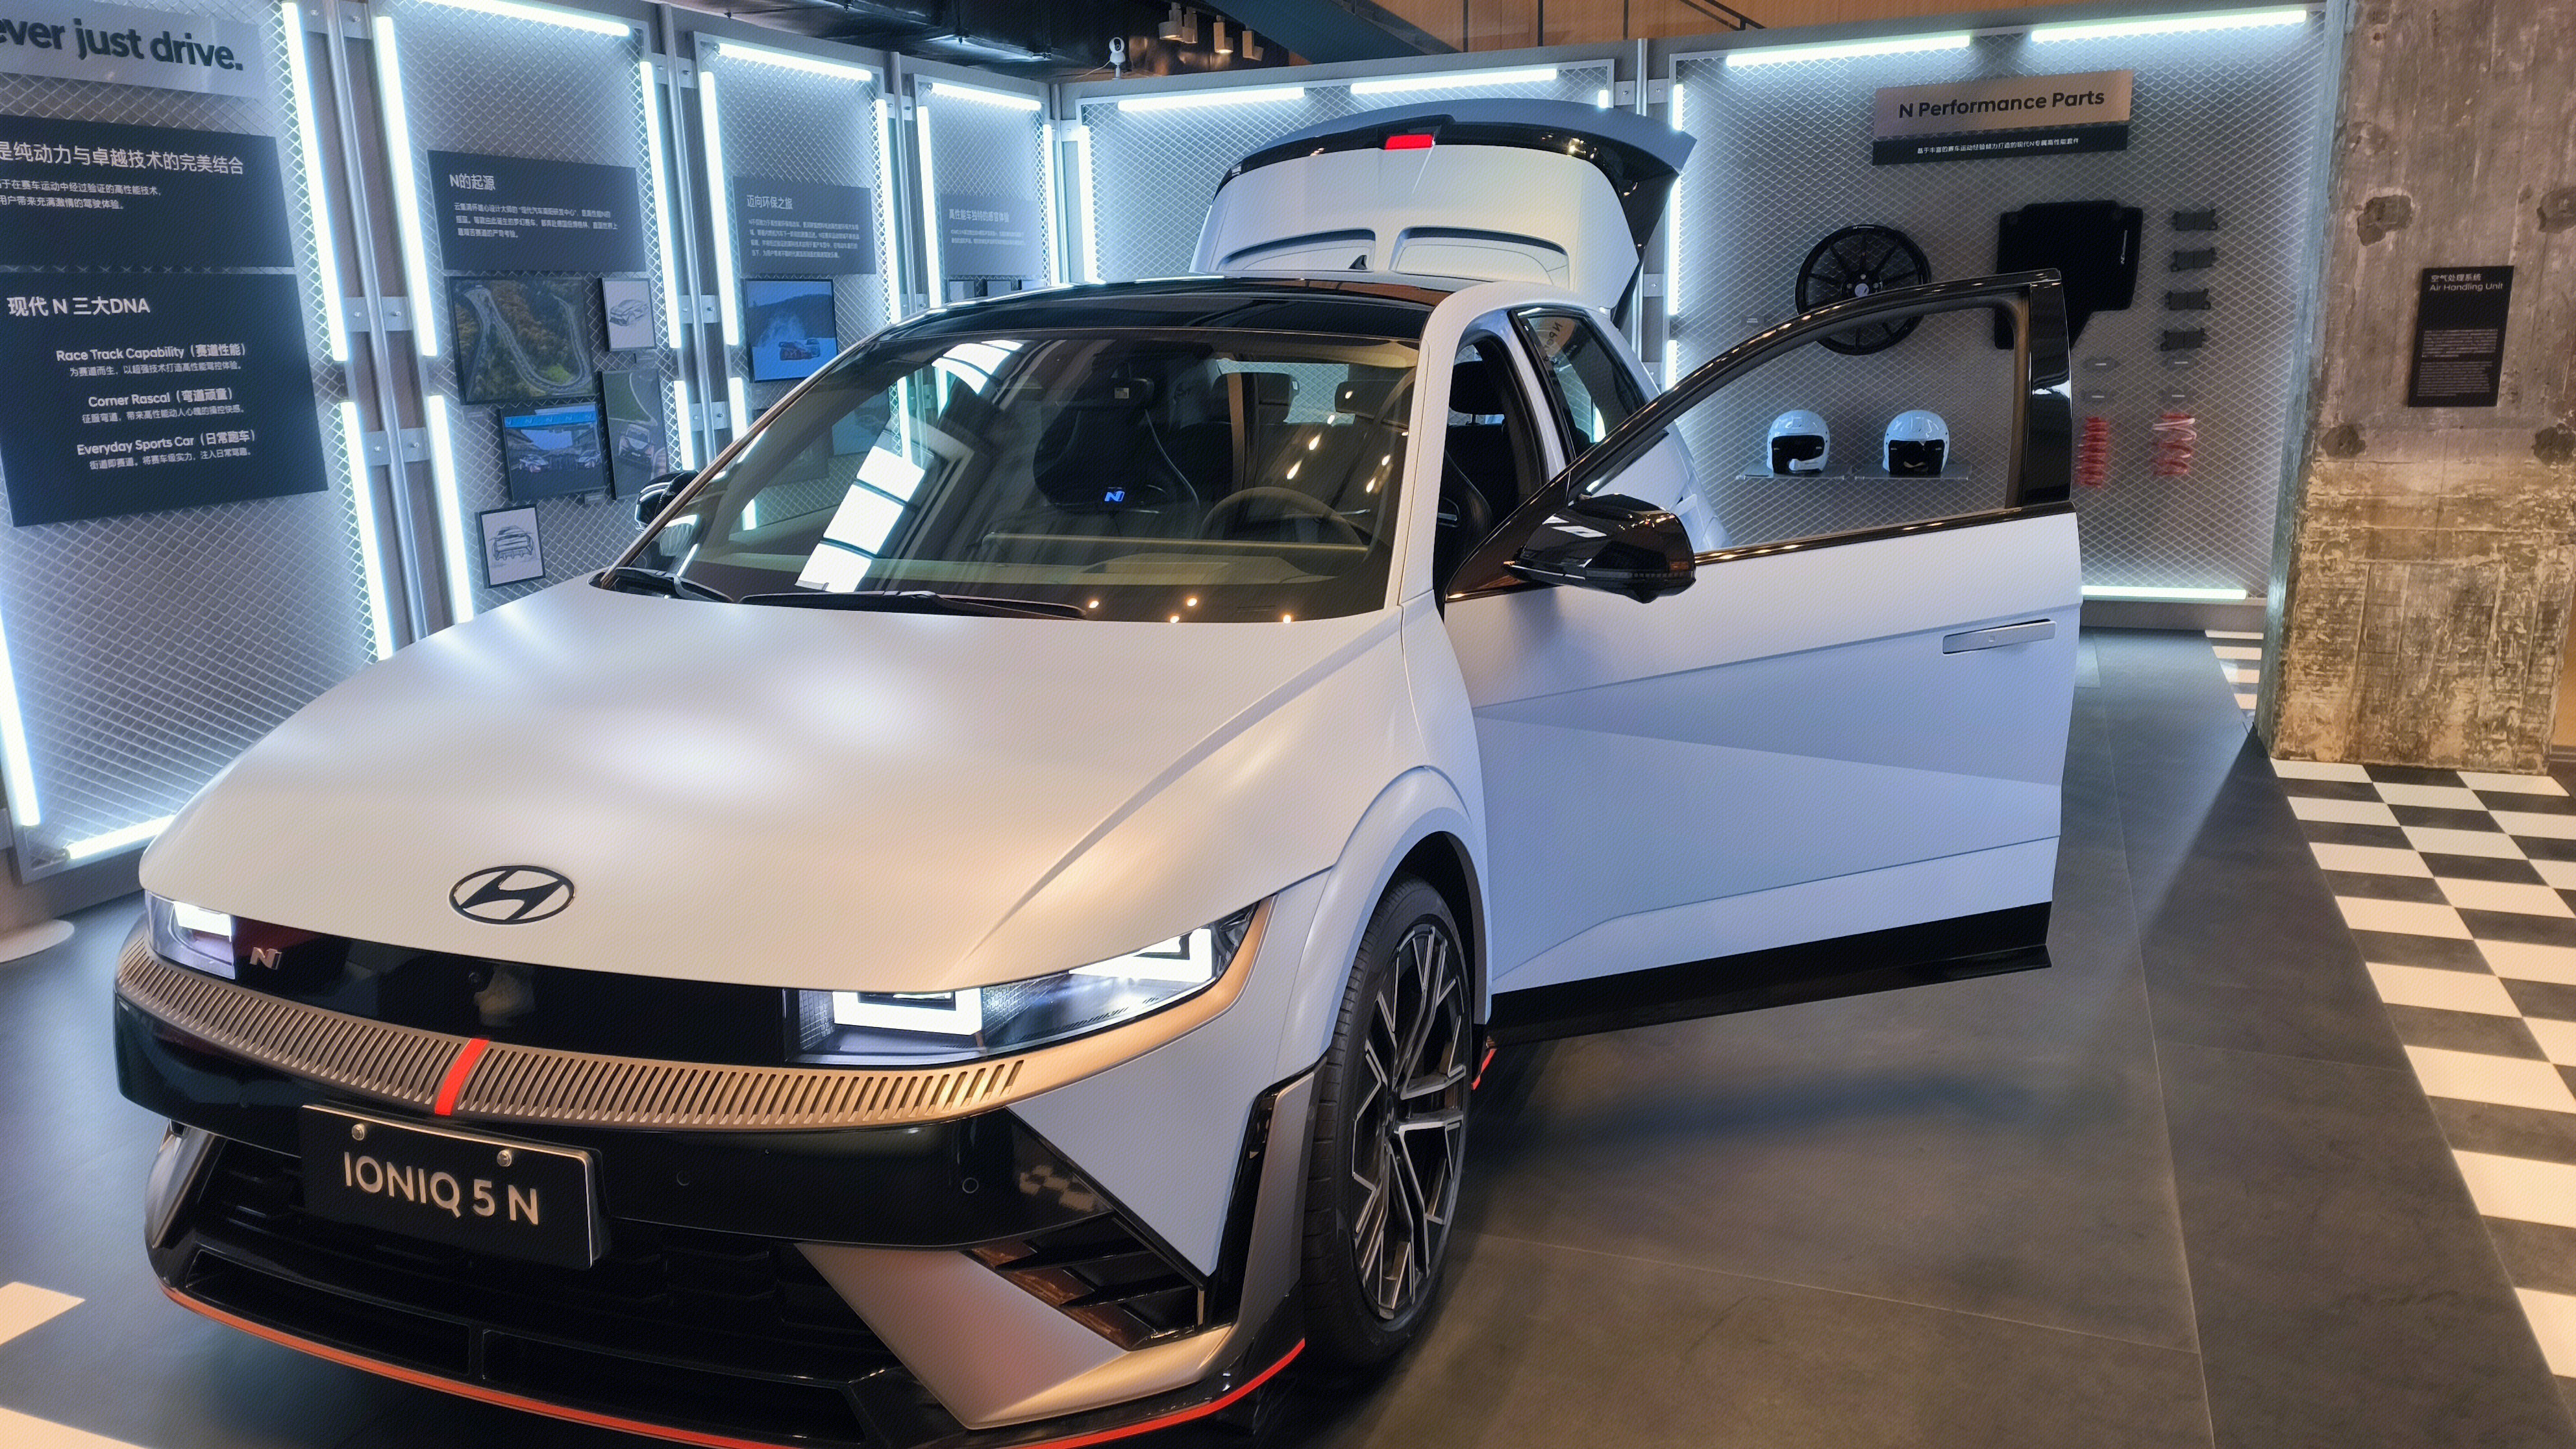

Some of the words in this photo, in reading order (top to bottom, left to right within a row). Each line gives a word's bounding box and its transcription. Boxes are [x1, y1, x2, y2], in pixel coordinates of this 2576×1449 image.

[73, 18, 145, 60] just
[150, 31, 243, 71] drive.
[1899, 103, 1913, 118] N
[1918, 97, 2047, 118] Performance
[2052, 91, 2105, 108] Parts
[0, 141, 243, 175] 是纯动力与卓越技术的完美结合
[0, 179, 162, 196] 于在赛车运动中经过验证的高性能技术，
[449, 173, 496, 191] N的起源
[746, 195, 793, 210] 迈向环保之旅
[2444, 283, 2483, 292] Handling
[2486, 282, 2503, 290] Unit
[6, 296, 49, 316] 现代
[53, 298, 68, 314] N
[73, 296, 151, 316] 三大DNA
[56, 349, 88, 362] Race
[90, 348, 123, 360] Track
[126, 346, 184, 360] Capability
[88, 395, 129, 407] Corner
[132, 392, 170, 404] Rascal
[77, 441, 132, 456] Everyday
[135, 438, 173, 451] Sports
[174, 436, 194, 447] Car
[249, 947, 282, 970] N
[344, 1151, 461, 1218] IONIQ
[473, 1178, 495, 1217] 5
[508, 1184, 538, 1226] N
